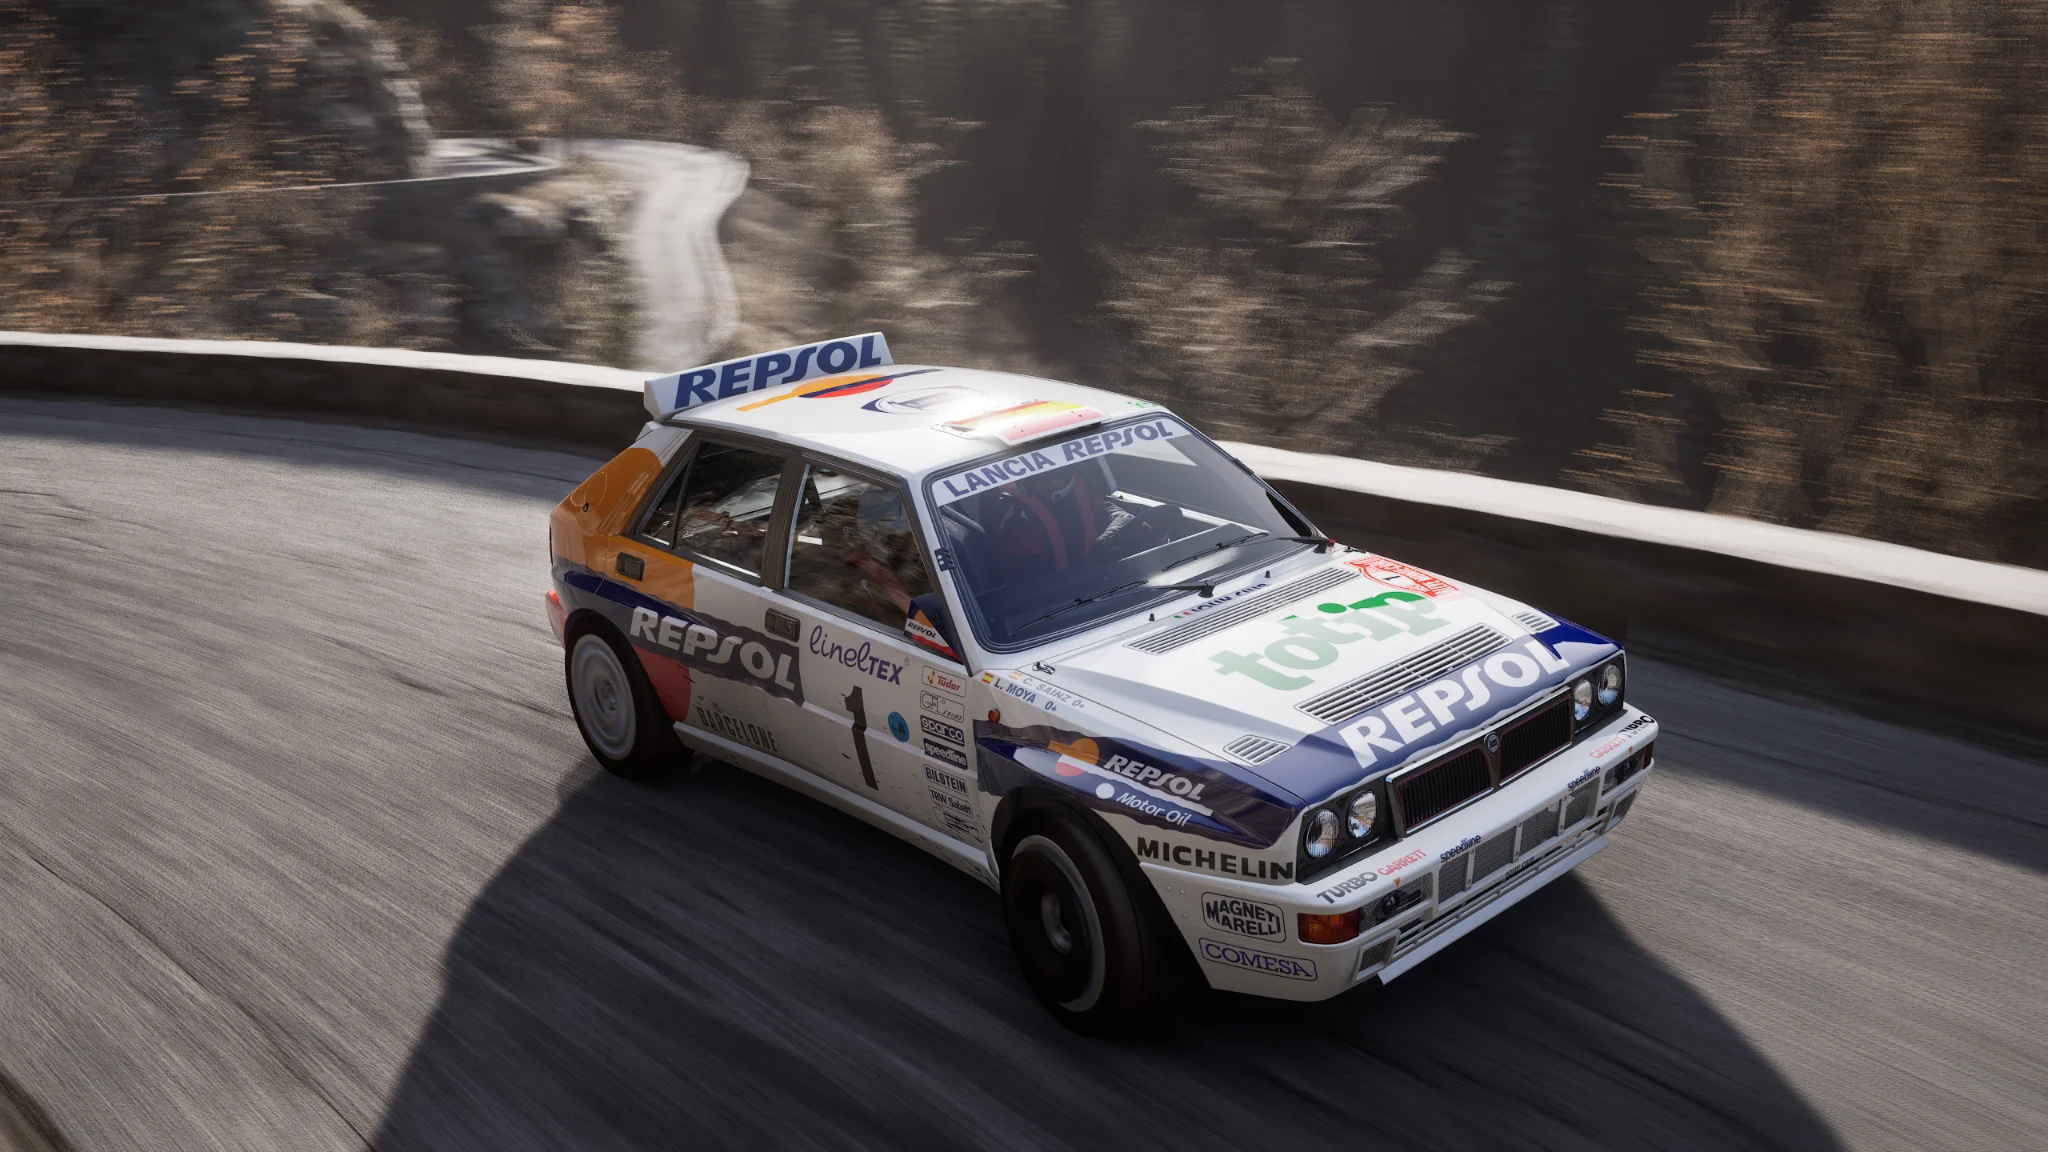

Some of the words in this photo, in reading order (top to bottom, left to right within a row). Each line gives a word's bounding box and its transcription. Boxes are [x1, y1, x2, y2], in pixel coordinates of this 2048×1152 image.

[673, 336, 882, 410] REPSOL
[943, 451, 1056, 498] LANCIA
[1063, 421, 1174, 464] REPSOL
[629, 605, 796, 691] REPSOL
[907, 621, 937, 640] REPSOL
[1207, 591, 1451, 692] totip
[937, 674, 961, 691] Tudor
[994, 678, 1003, 690] L.
[1006, 683, 1037, 704] MOYA
[1036, 684, 1072, 703] SAINZ
[1339, 640, 1571, 769] REPSOL
[696, 706, 779, 753] BARCELONE
[844, 685, 880, 791] 1
[921, 718, 964, 742] sparco
[924, 741, 967, 767] speedline
[925, 766, 967, 795] BILSTEIN
[1103, 754, 1206, 801] REPSOL
[1115, 792, 1166, 817] Motor
[1165, 809, 1193, 828] Oil
[1136, 836, 1294, 880] MICHELIN
[1316, 871, 1378, 904] TURBO
[1377, 848, 1427, 876] GARRETT
[1206, 899, 1281, 926] MAGNETI
[1206, 908, 1281, 936] MARELLI
[1205, 943, 1313, 978] COMESA
